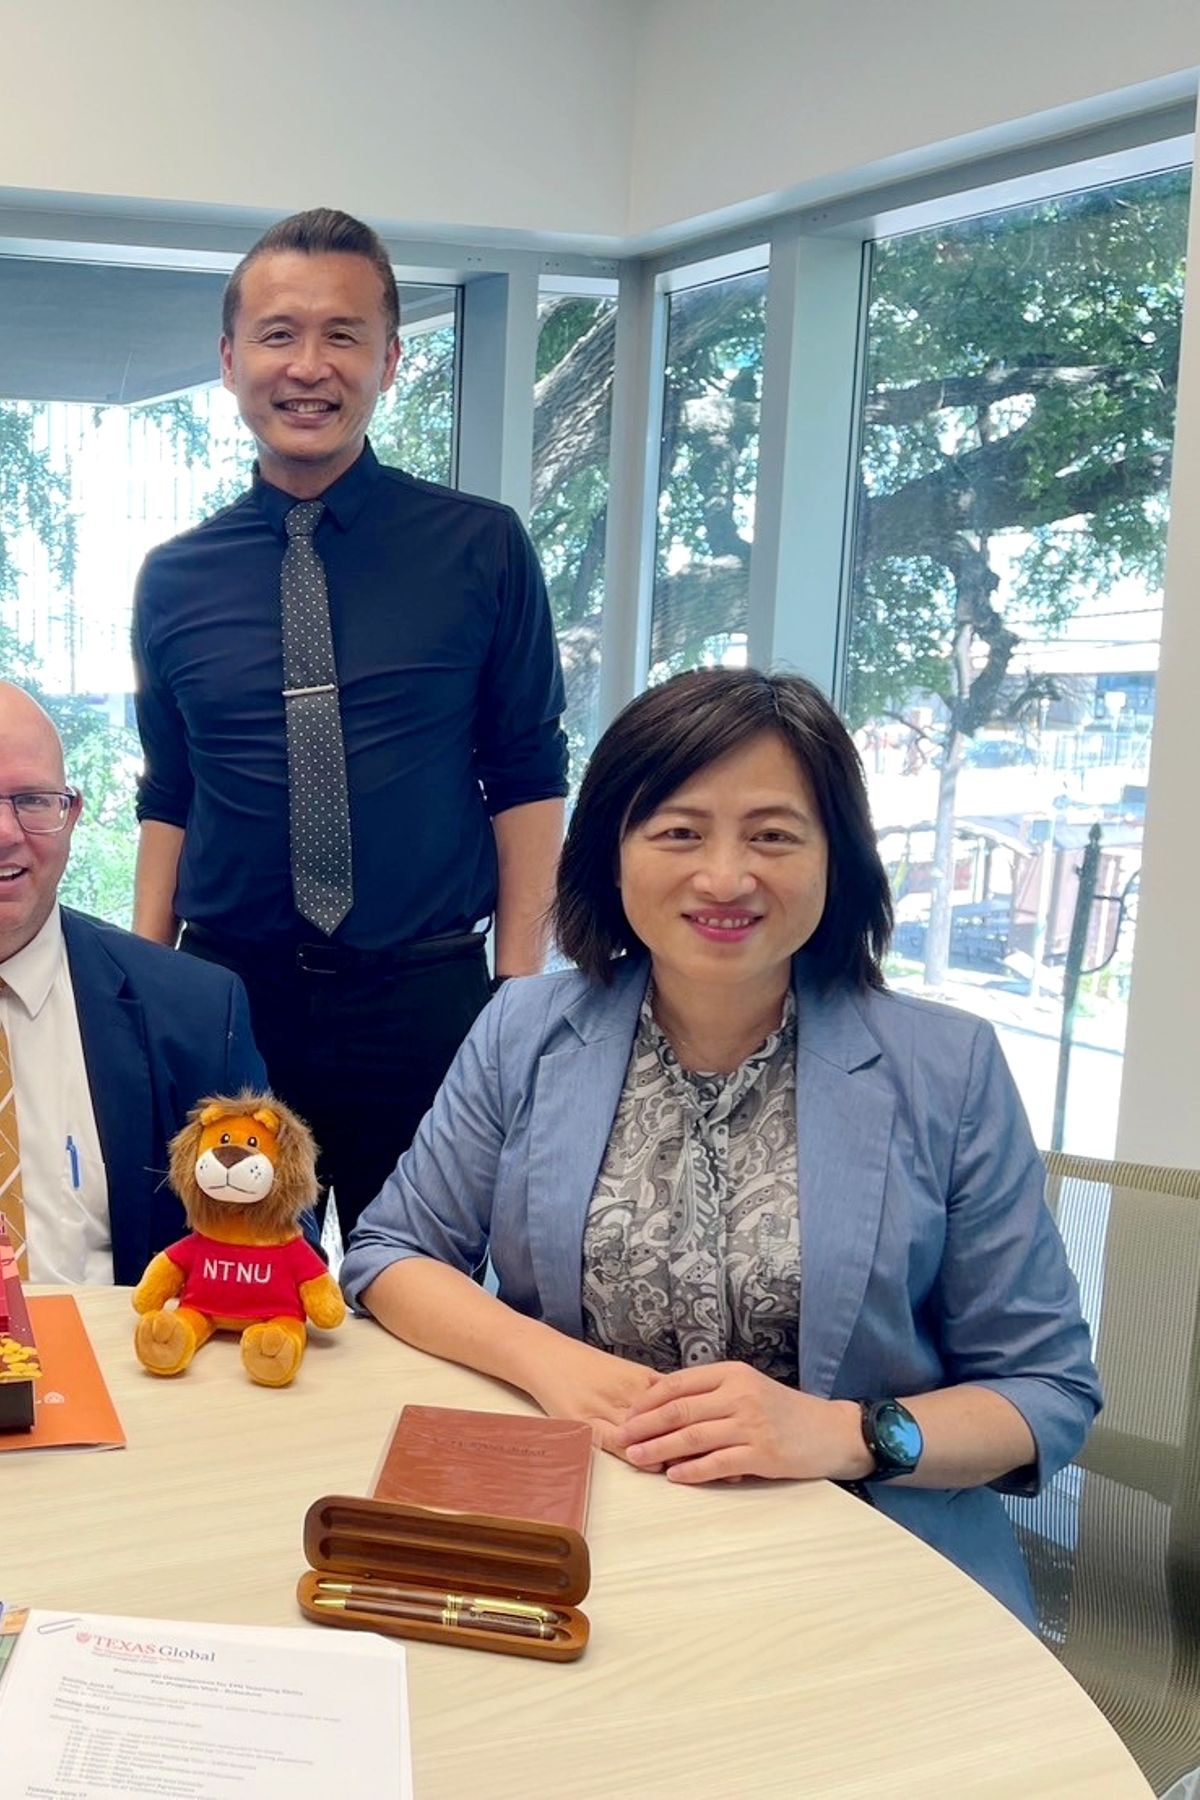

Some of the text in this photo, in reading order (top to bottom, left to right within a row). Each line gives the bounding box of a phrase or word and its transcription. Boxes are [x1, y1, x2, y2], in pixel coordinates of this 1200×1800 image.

[203, 1258, 271, 1284] NTNU
[93, 1634, 157, 1654] TEXAS
[159, 1645, 215, 1662] Global
